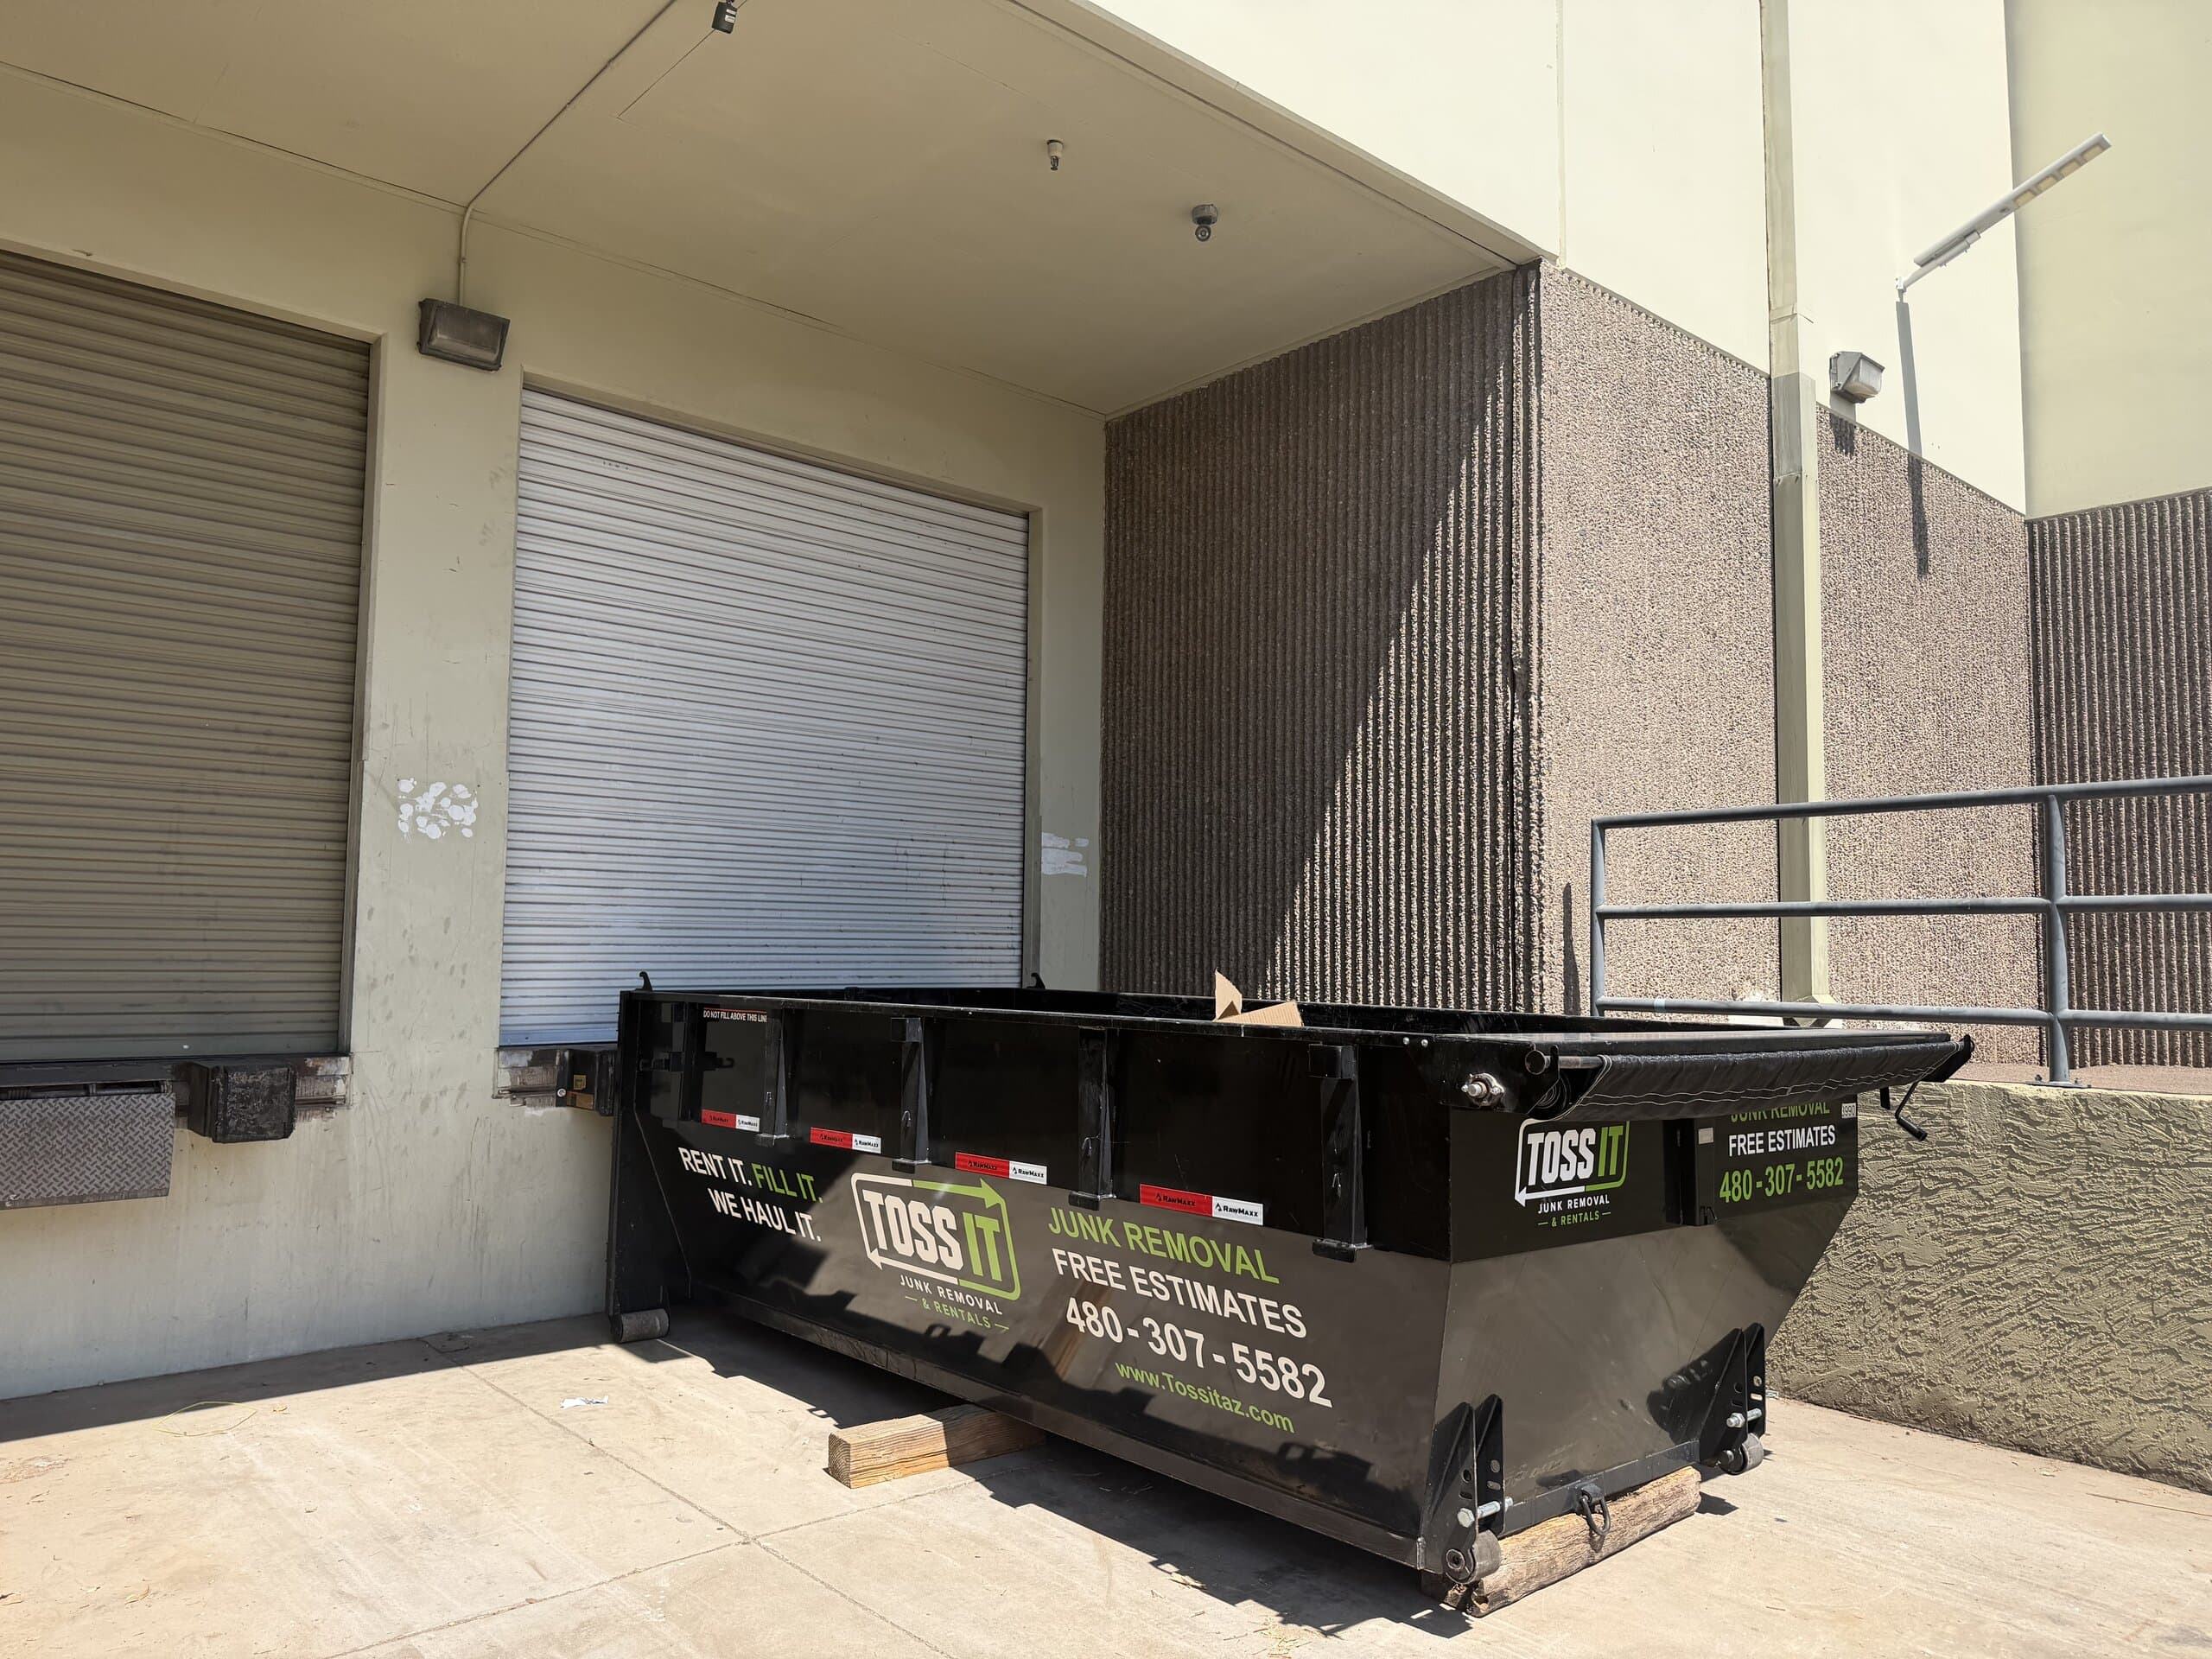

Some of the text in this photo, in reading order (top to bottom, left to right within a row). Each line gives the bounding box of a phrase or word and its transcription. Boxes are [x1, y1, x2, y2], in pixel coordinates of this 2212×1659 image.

[730, 1013, 746, 1021] ABOVE
[747, 1014, 757, 1022] THIS
[1527, 1125, 1624, 1186] TOSS IT
[1728, 1124, 1836, 1157] FREE ESTIMATES
[677, 1147, 823, 1204] RENT IT. FILL IT.
[707, 1187, 822, 1243] WE HAUL IT.
[1538, 1194, 1611, 1214] JUNK REMOVAL
[1551, 1211, 1600, 1228] & RENTALS
[861, 1189, 1003, 1282] TOSS IT
[1047, 1207, 1281, 1285] JUNK REMOVAL
[899, 1274, 1004, 1315] JUNK REMOVAL
[921, 1297, 992, 1329] & RENTALS
[1052, 1248, 1307, 1338] FREE ESTIMATES
[1115, 1362, 1295, 1433] www.Tossitaz.com
